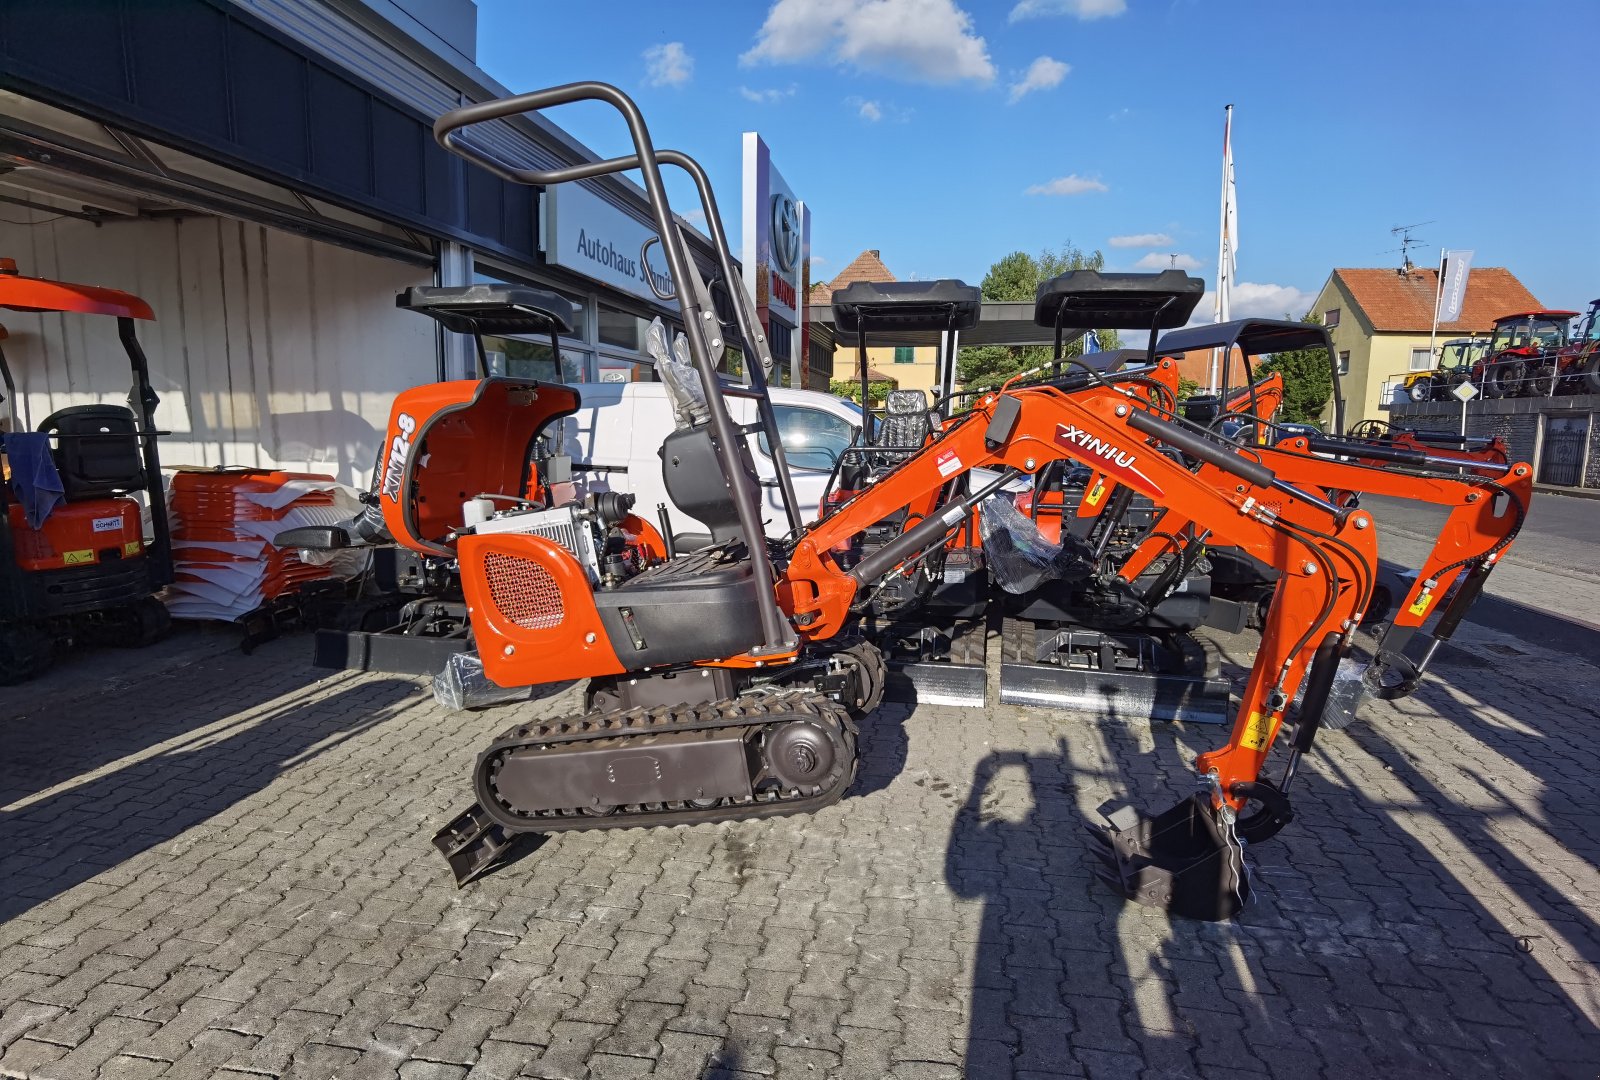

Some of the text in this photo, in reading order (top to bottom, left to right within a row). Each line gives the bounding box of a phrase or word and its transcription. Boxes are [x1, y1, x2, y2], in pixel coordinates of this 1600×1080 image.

[577, 228, 636, 278] Autohaus
[382, 412, 416, 504] XN12-8
[1060, 423, 1137, 468] XINIU
